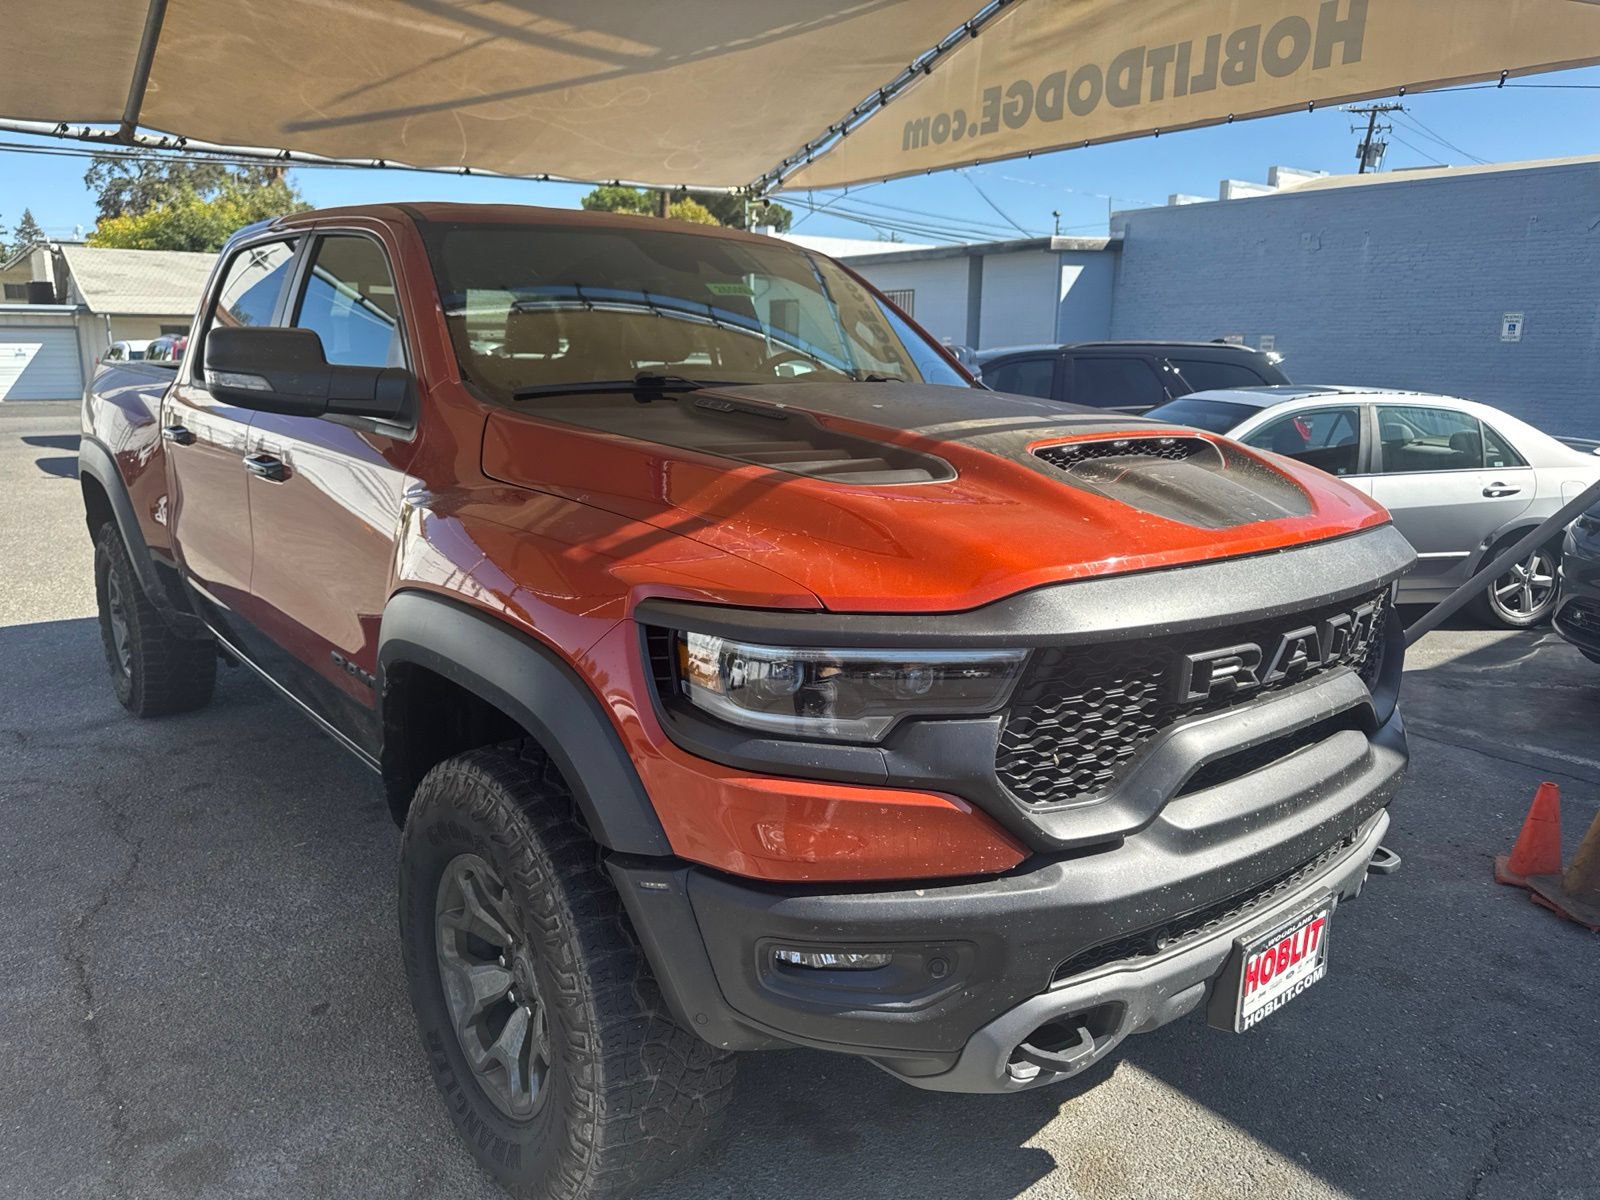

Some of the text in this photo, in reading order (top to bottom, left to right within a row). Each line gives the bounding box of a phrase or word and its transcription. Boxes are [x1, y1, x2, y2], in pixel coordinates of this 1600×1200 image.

[1179, 601, 1378, 704] RAM
[1244, 917, 1326, 999] HOBLIT
[1268, 914, 1314, 947] WOODLAND
[1243, 967, 1324, 1031] HOBLIT.COM
